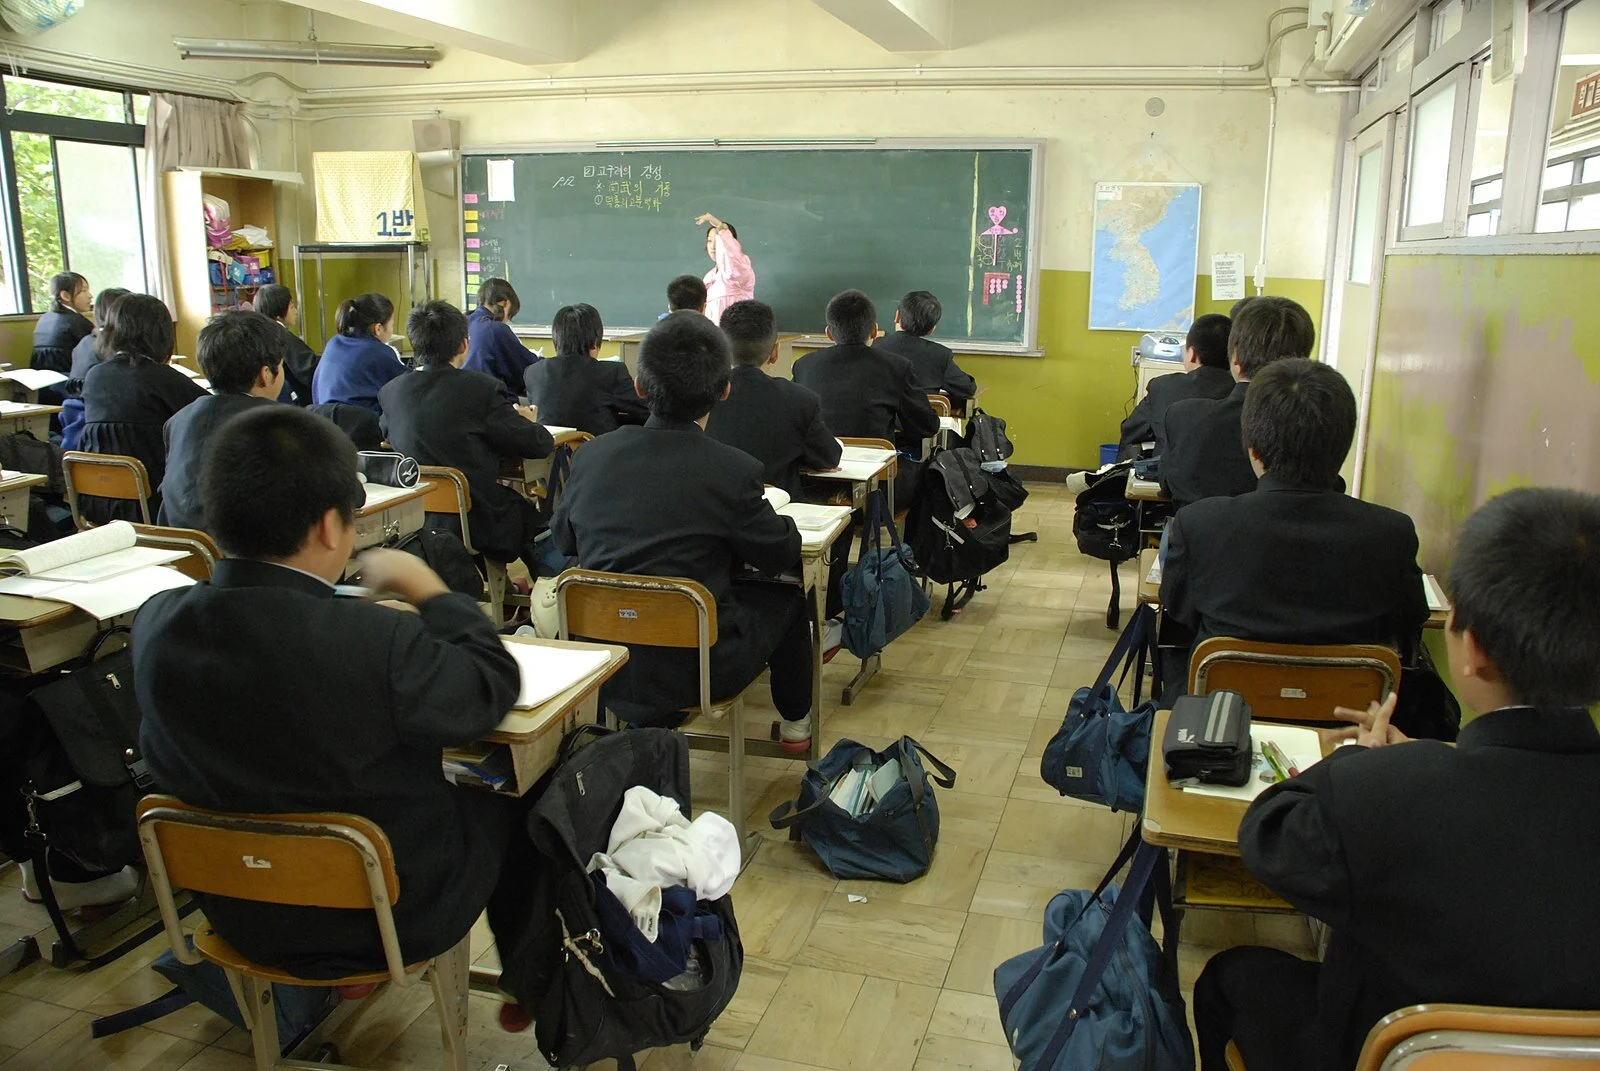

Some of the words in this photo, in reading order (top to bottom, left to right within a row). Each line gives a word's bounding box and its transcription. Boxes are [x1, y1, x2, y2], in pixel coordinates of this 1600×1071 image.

[597, 164, 631, 179] 고구려의
[640, 163, 662, 181] 강성
[376, 209, 414, 237] 1반
